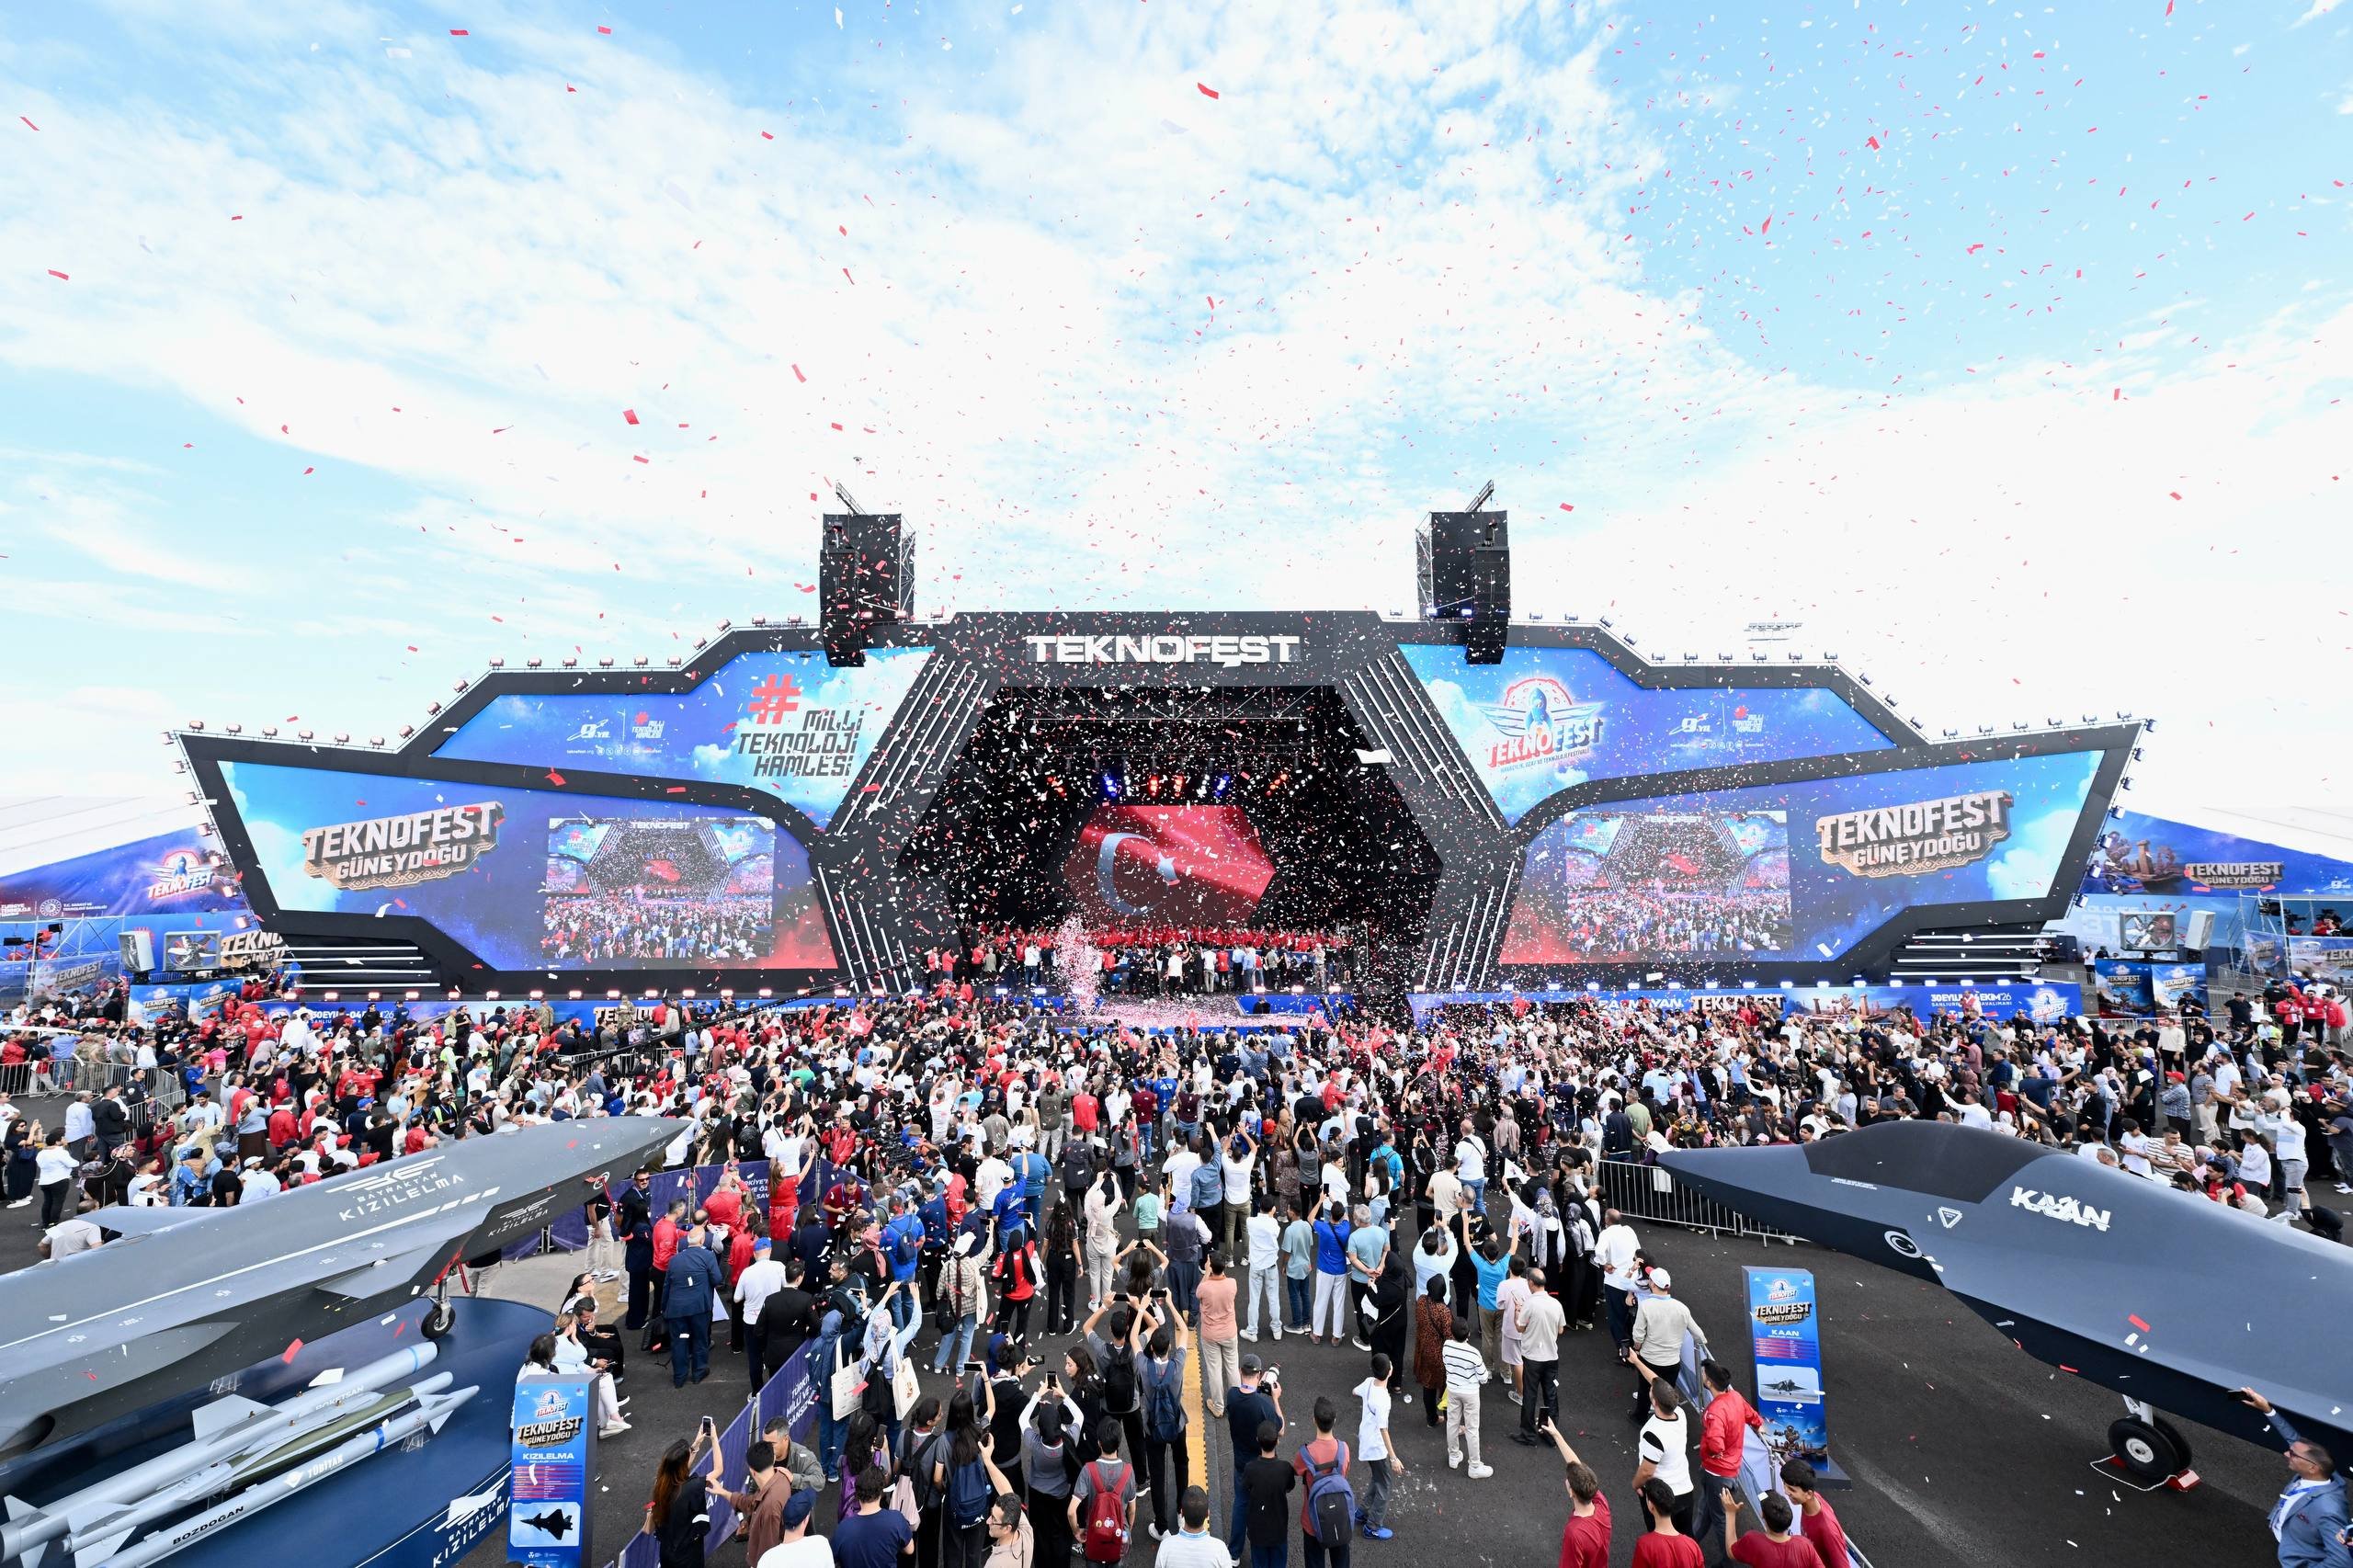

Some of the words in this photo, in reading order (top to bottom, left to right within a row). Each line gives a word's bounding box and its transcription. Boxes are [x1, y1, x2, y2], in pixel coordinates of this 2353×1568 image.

[1026, 635, 1300, 667] TEKNOFEST
[1484, 718, 1604, 768] TEKNOFEST
[302, 801, 502, 861] TEKNOFEST
[1816, 790, 2012, 849] TEKNOFEST
[335, 843, 467, 880] GÜNEYDOĞU
[1852, 832, 1981, 868] GÜNEYDOĞU
[2186, 862, 2282, 878] TEKNOFEST
[147, 871, 215, 900] TEKNOFEST
[55, 961, 103, 983] TEKNOFEST
[2165, 978, 2196, 988] TEKNOFEST
[143, 998, 178, 1008] TEKNOFEST
[2034, 1003, 2067, 1017] TEKNOFEST
[338, 1174, 464, 1221] KIZILELMA
[2008, 1186, 2111, 1233] KAAN
[487, 1209, 549, 1237] KIZILELMA
[1756, 1301, 1812, 1317] TEKNOFEST
[517, 1415, 584, 1439] TEKNOFEST
[522, 1452, 574, 1460] KIZILELMA
